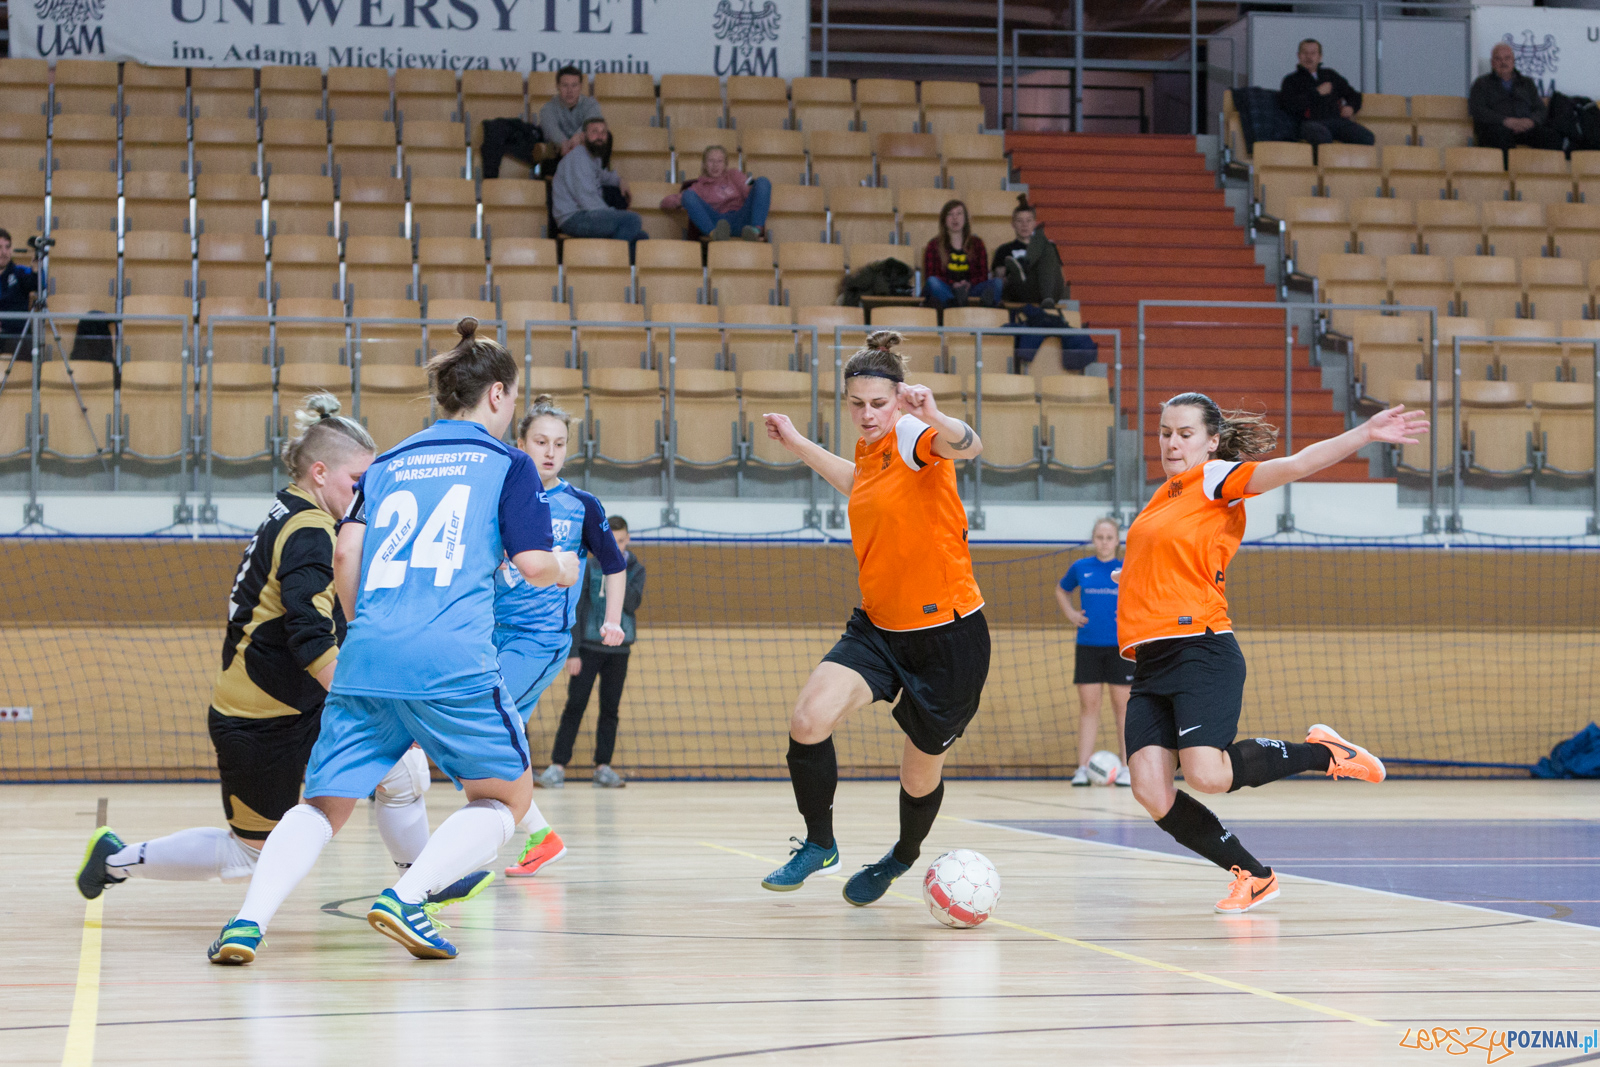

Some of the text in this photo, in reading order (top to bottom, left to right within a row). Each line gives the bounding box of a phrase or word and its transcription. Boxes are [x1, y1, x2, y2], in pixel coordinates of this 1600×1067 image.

[171, 0, 656, 35] UNIWERSYTET
[37, 24, 105, 57] UAM
[172, 40, 213, 61] im.
[223, 44, 318, 66] Adama
[328, 46, 490, 70] Mickiewicza
[499, 55, 521, 72] w
[713, 45, 778, 77] UAM
[394, 465, 468, 482] WARSZAWSKI
[407, 452, 488, 466] UNIWERSYTET
[364, 484, 471, 591] 24
